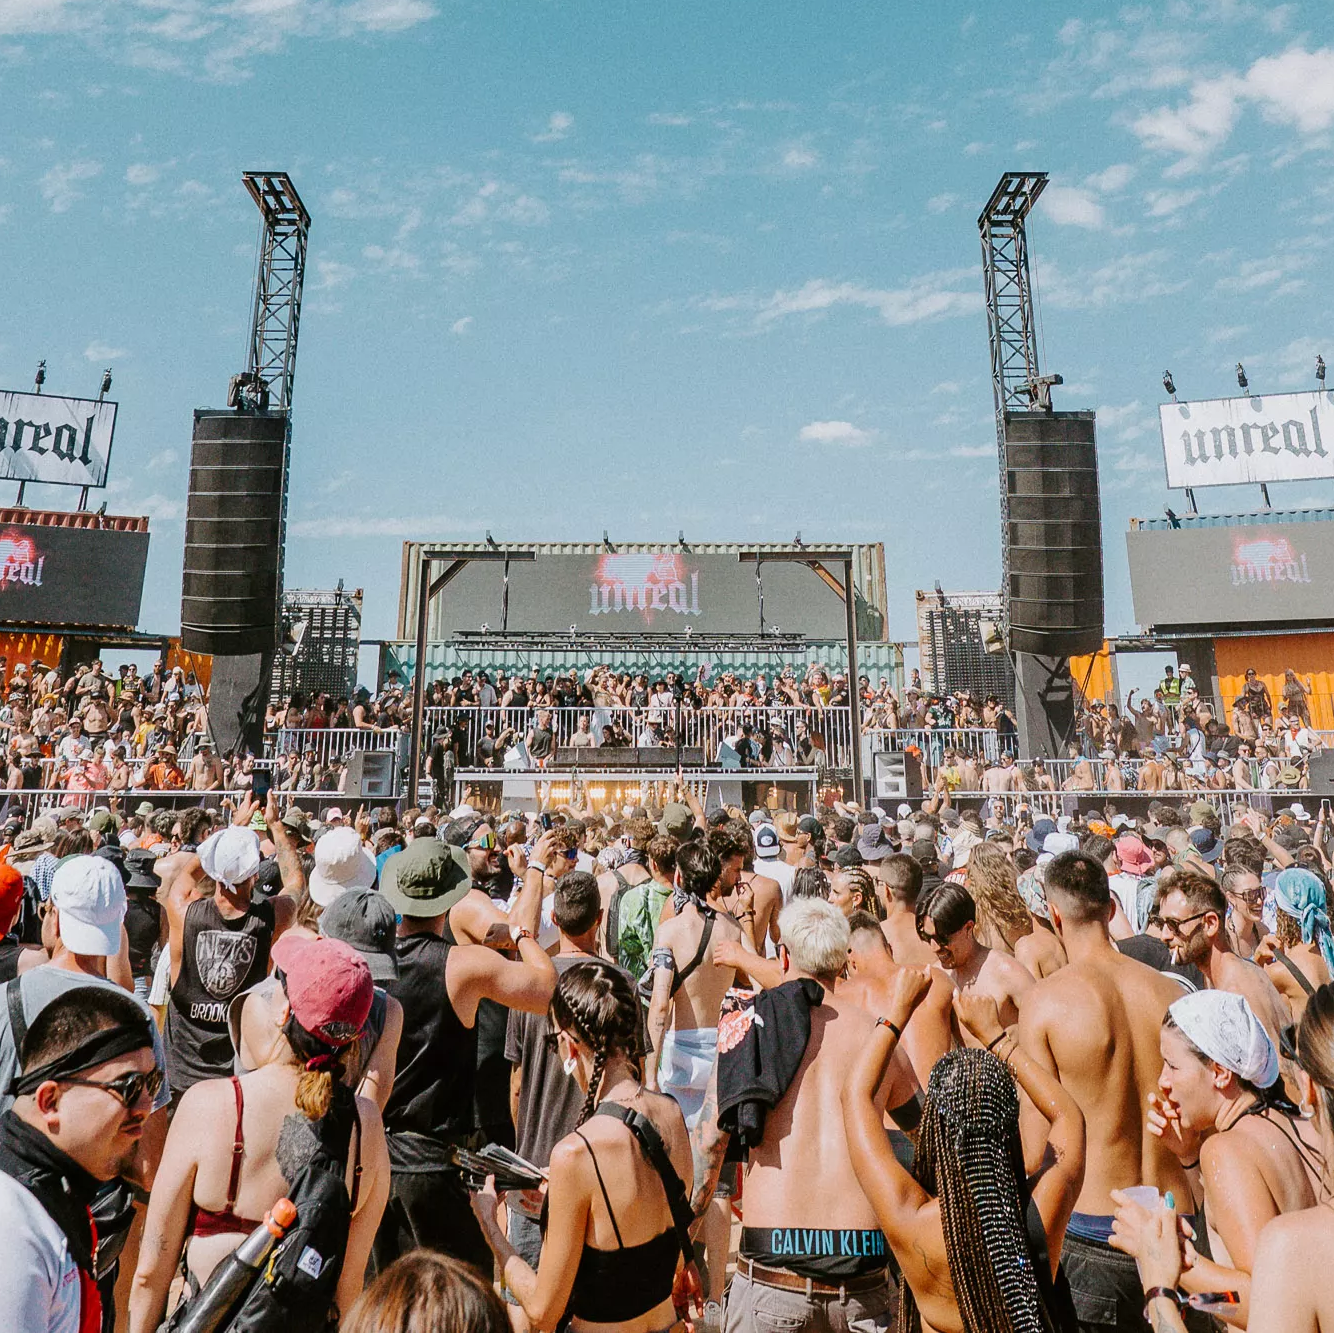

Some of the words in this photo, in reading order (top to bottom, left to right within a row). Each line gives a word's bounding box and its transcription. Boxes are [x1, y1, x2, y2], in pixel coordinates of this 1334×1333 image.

[1180, 405, 1329, 466] unreal
[1230, 552, 1312, 586] unreal
[588, 569, 703, 617] unreal
[771, 1228, 834, 1256] CALVIN
[840, 1229, 885, 1256] KLEIN
